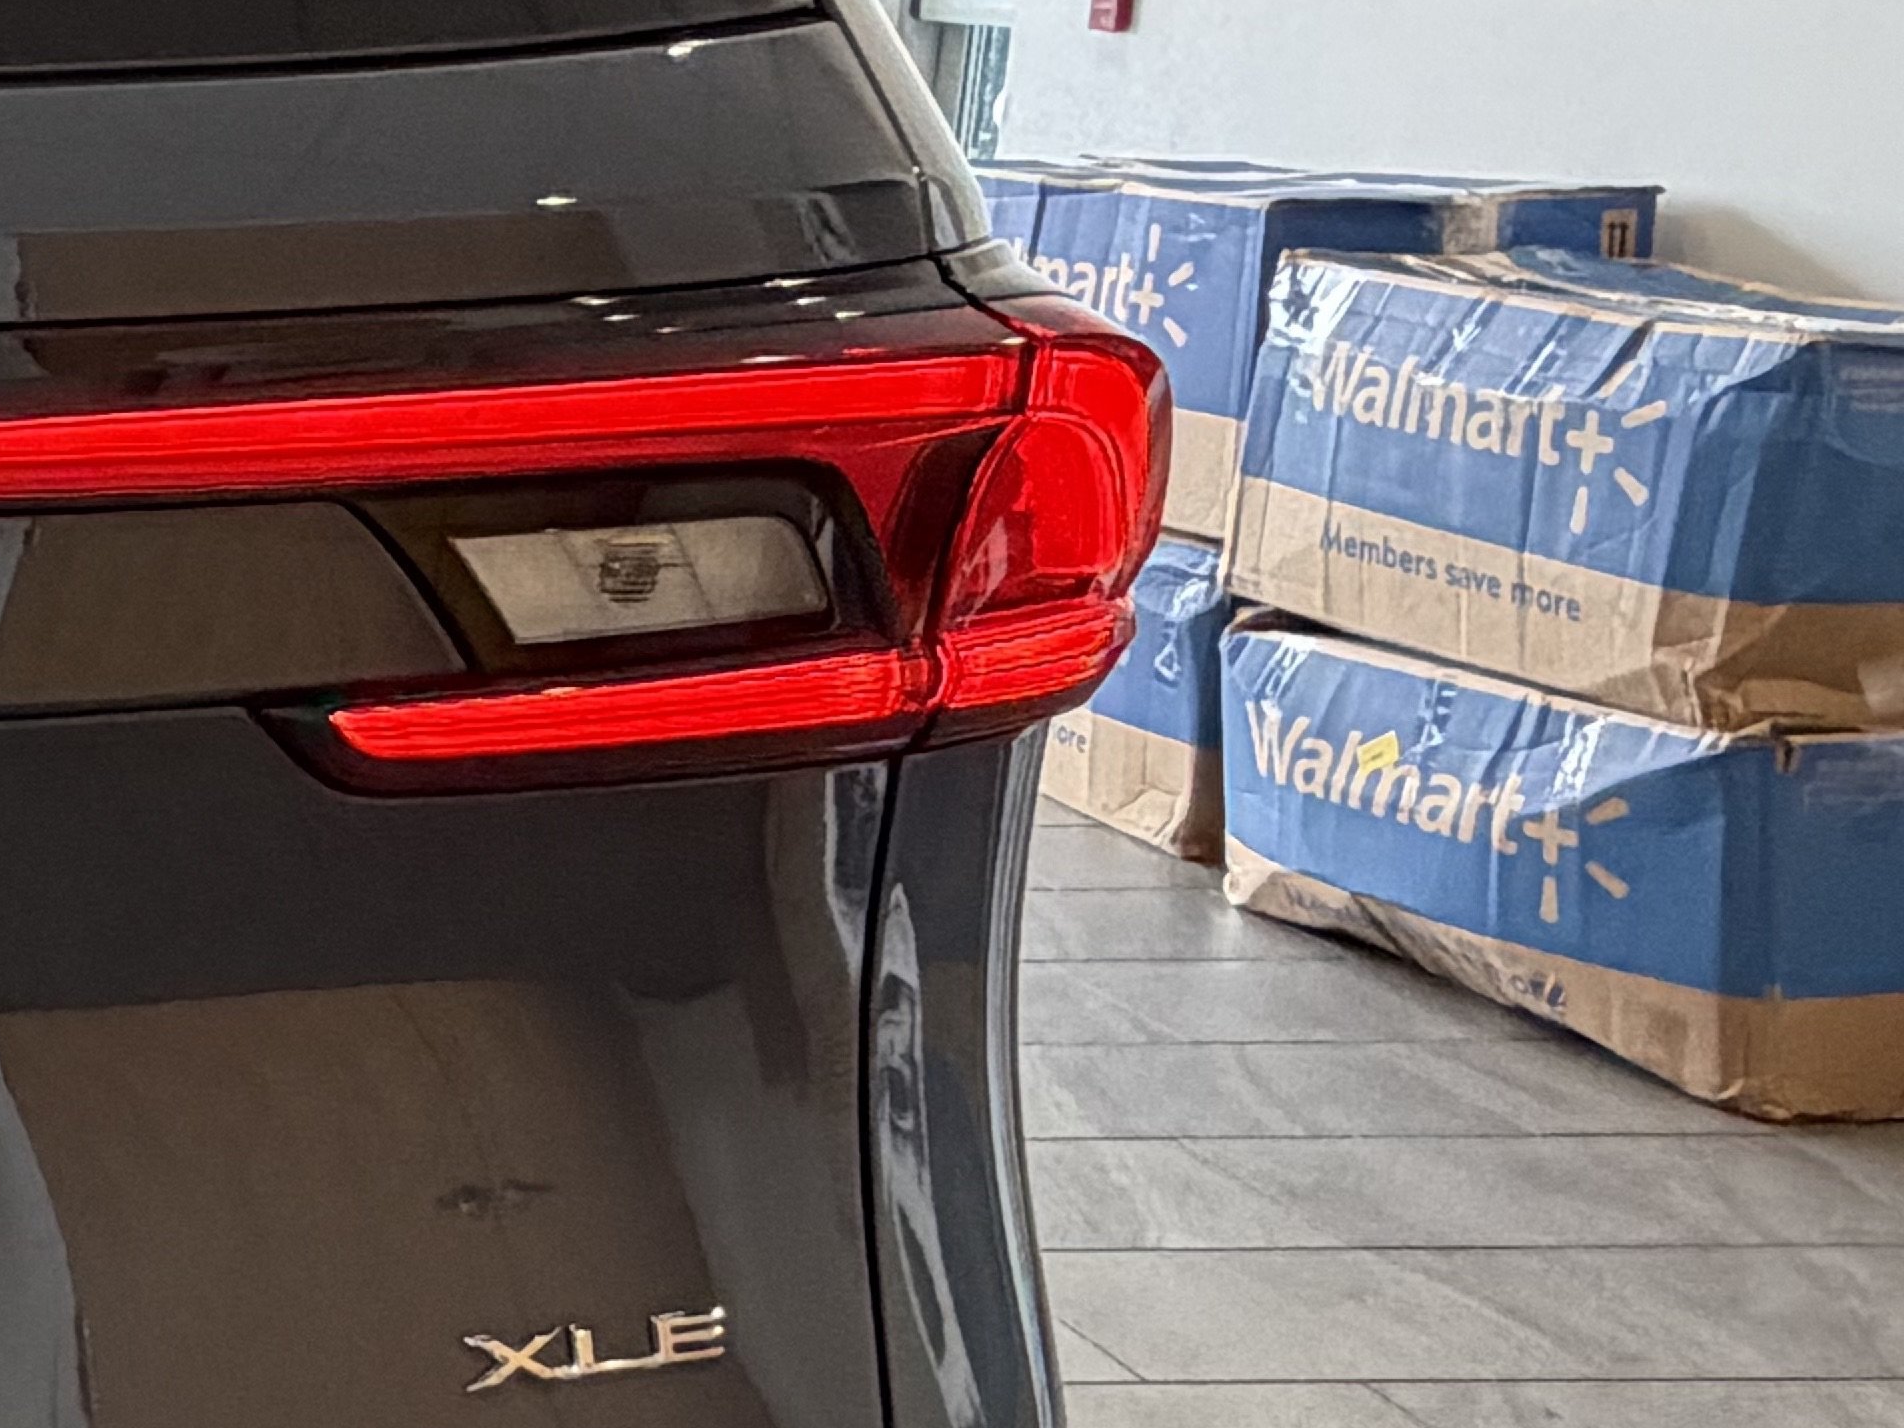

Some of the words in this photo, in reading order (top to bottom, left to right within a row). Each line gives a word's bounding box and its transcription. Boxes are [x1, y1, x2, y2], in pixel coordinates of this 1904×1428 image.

[1009, 236, 1164, 325] mart+
[1319, 523, 1438, 580] Members
[1444, 561, 1502, 599] save
[1510, 582, 1582, 622] more
[1055, 724, 1088, 754] ore
[462, 1304, 727, 1393] XLE
